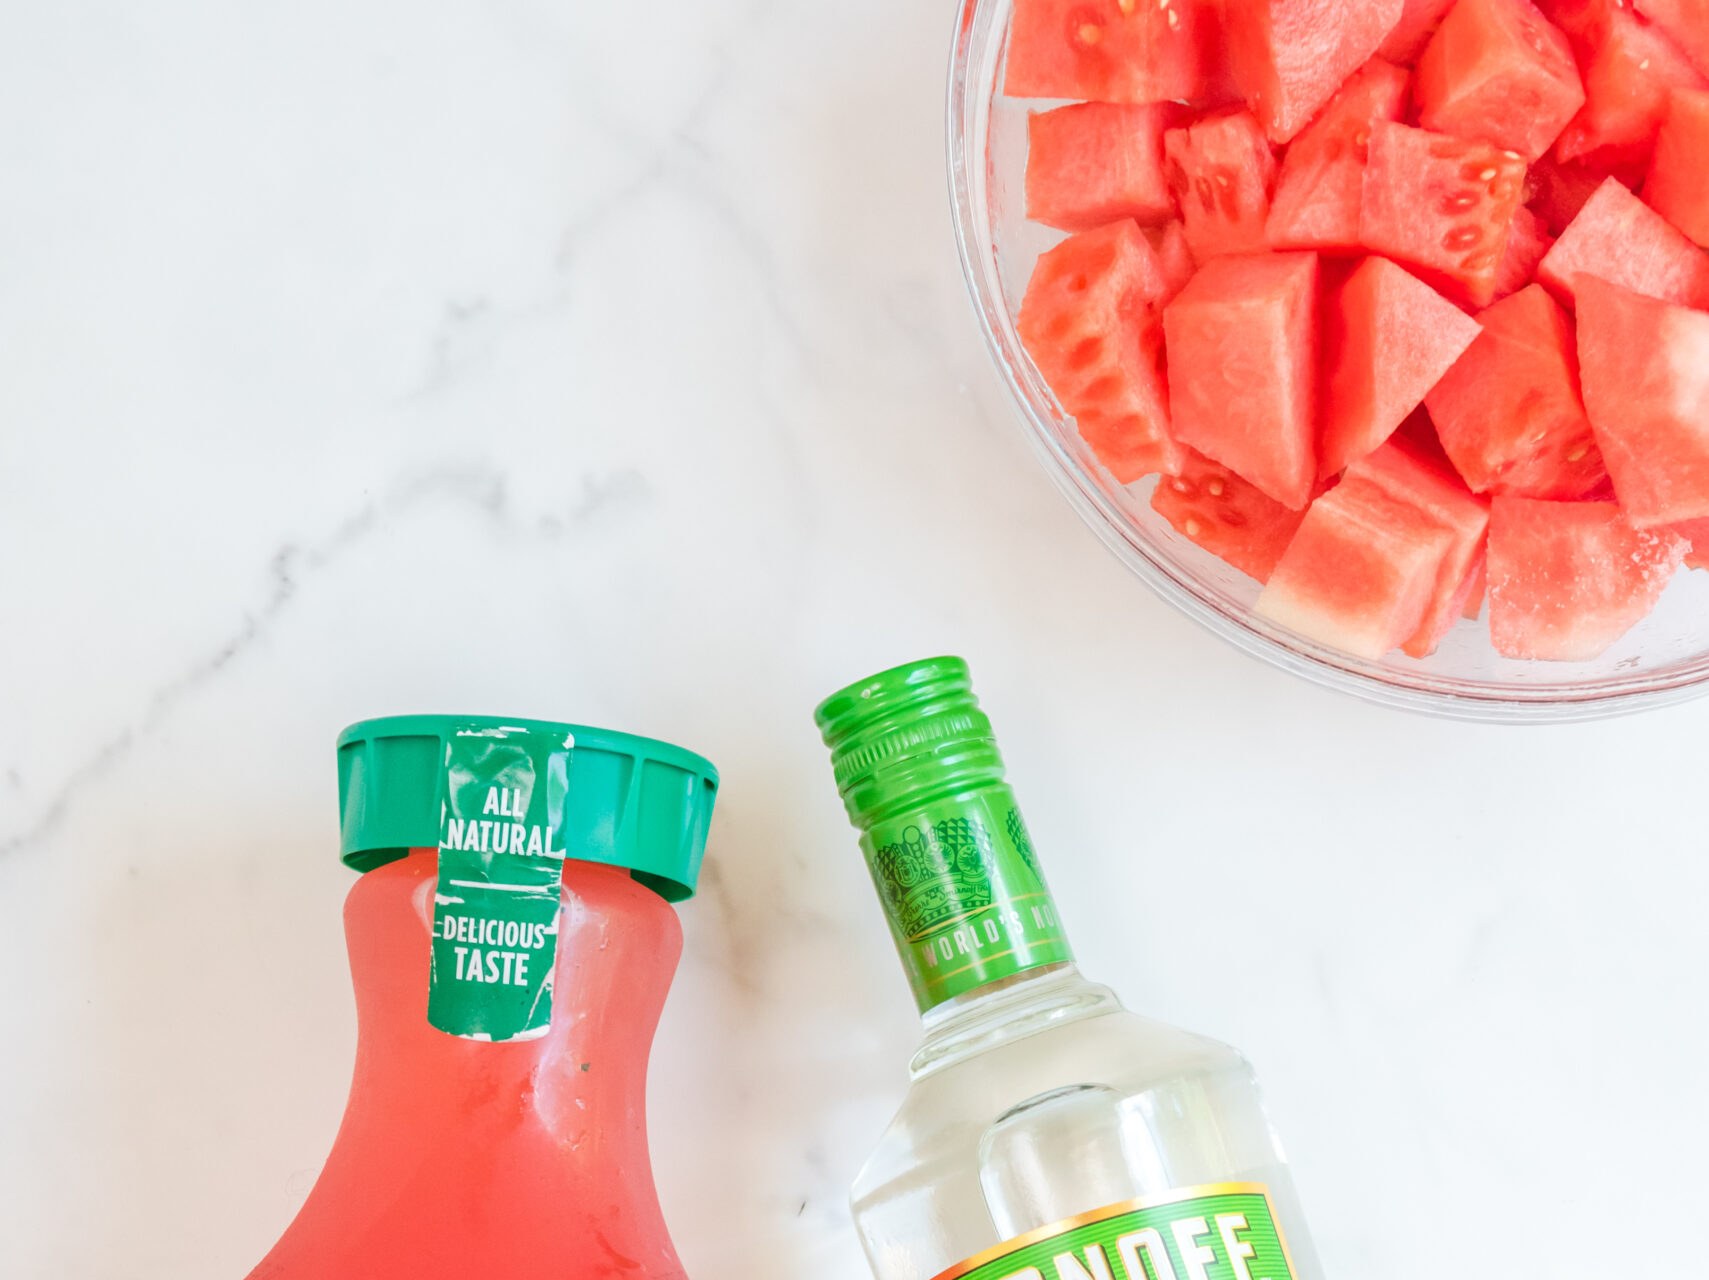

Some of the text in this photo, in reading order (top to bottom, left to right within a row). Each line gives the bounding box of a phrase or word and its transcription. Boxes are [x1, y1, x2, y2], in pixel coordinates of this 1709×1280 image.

[482, 786, 524, 817] ALL
[447, 819, 553, 857] NATURAL
[443, 915, 545, 949] DELICIOUS
[454, 946, 530, 986] TASTE
